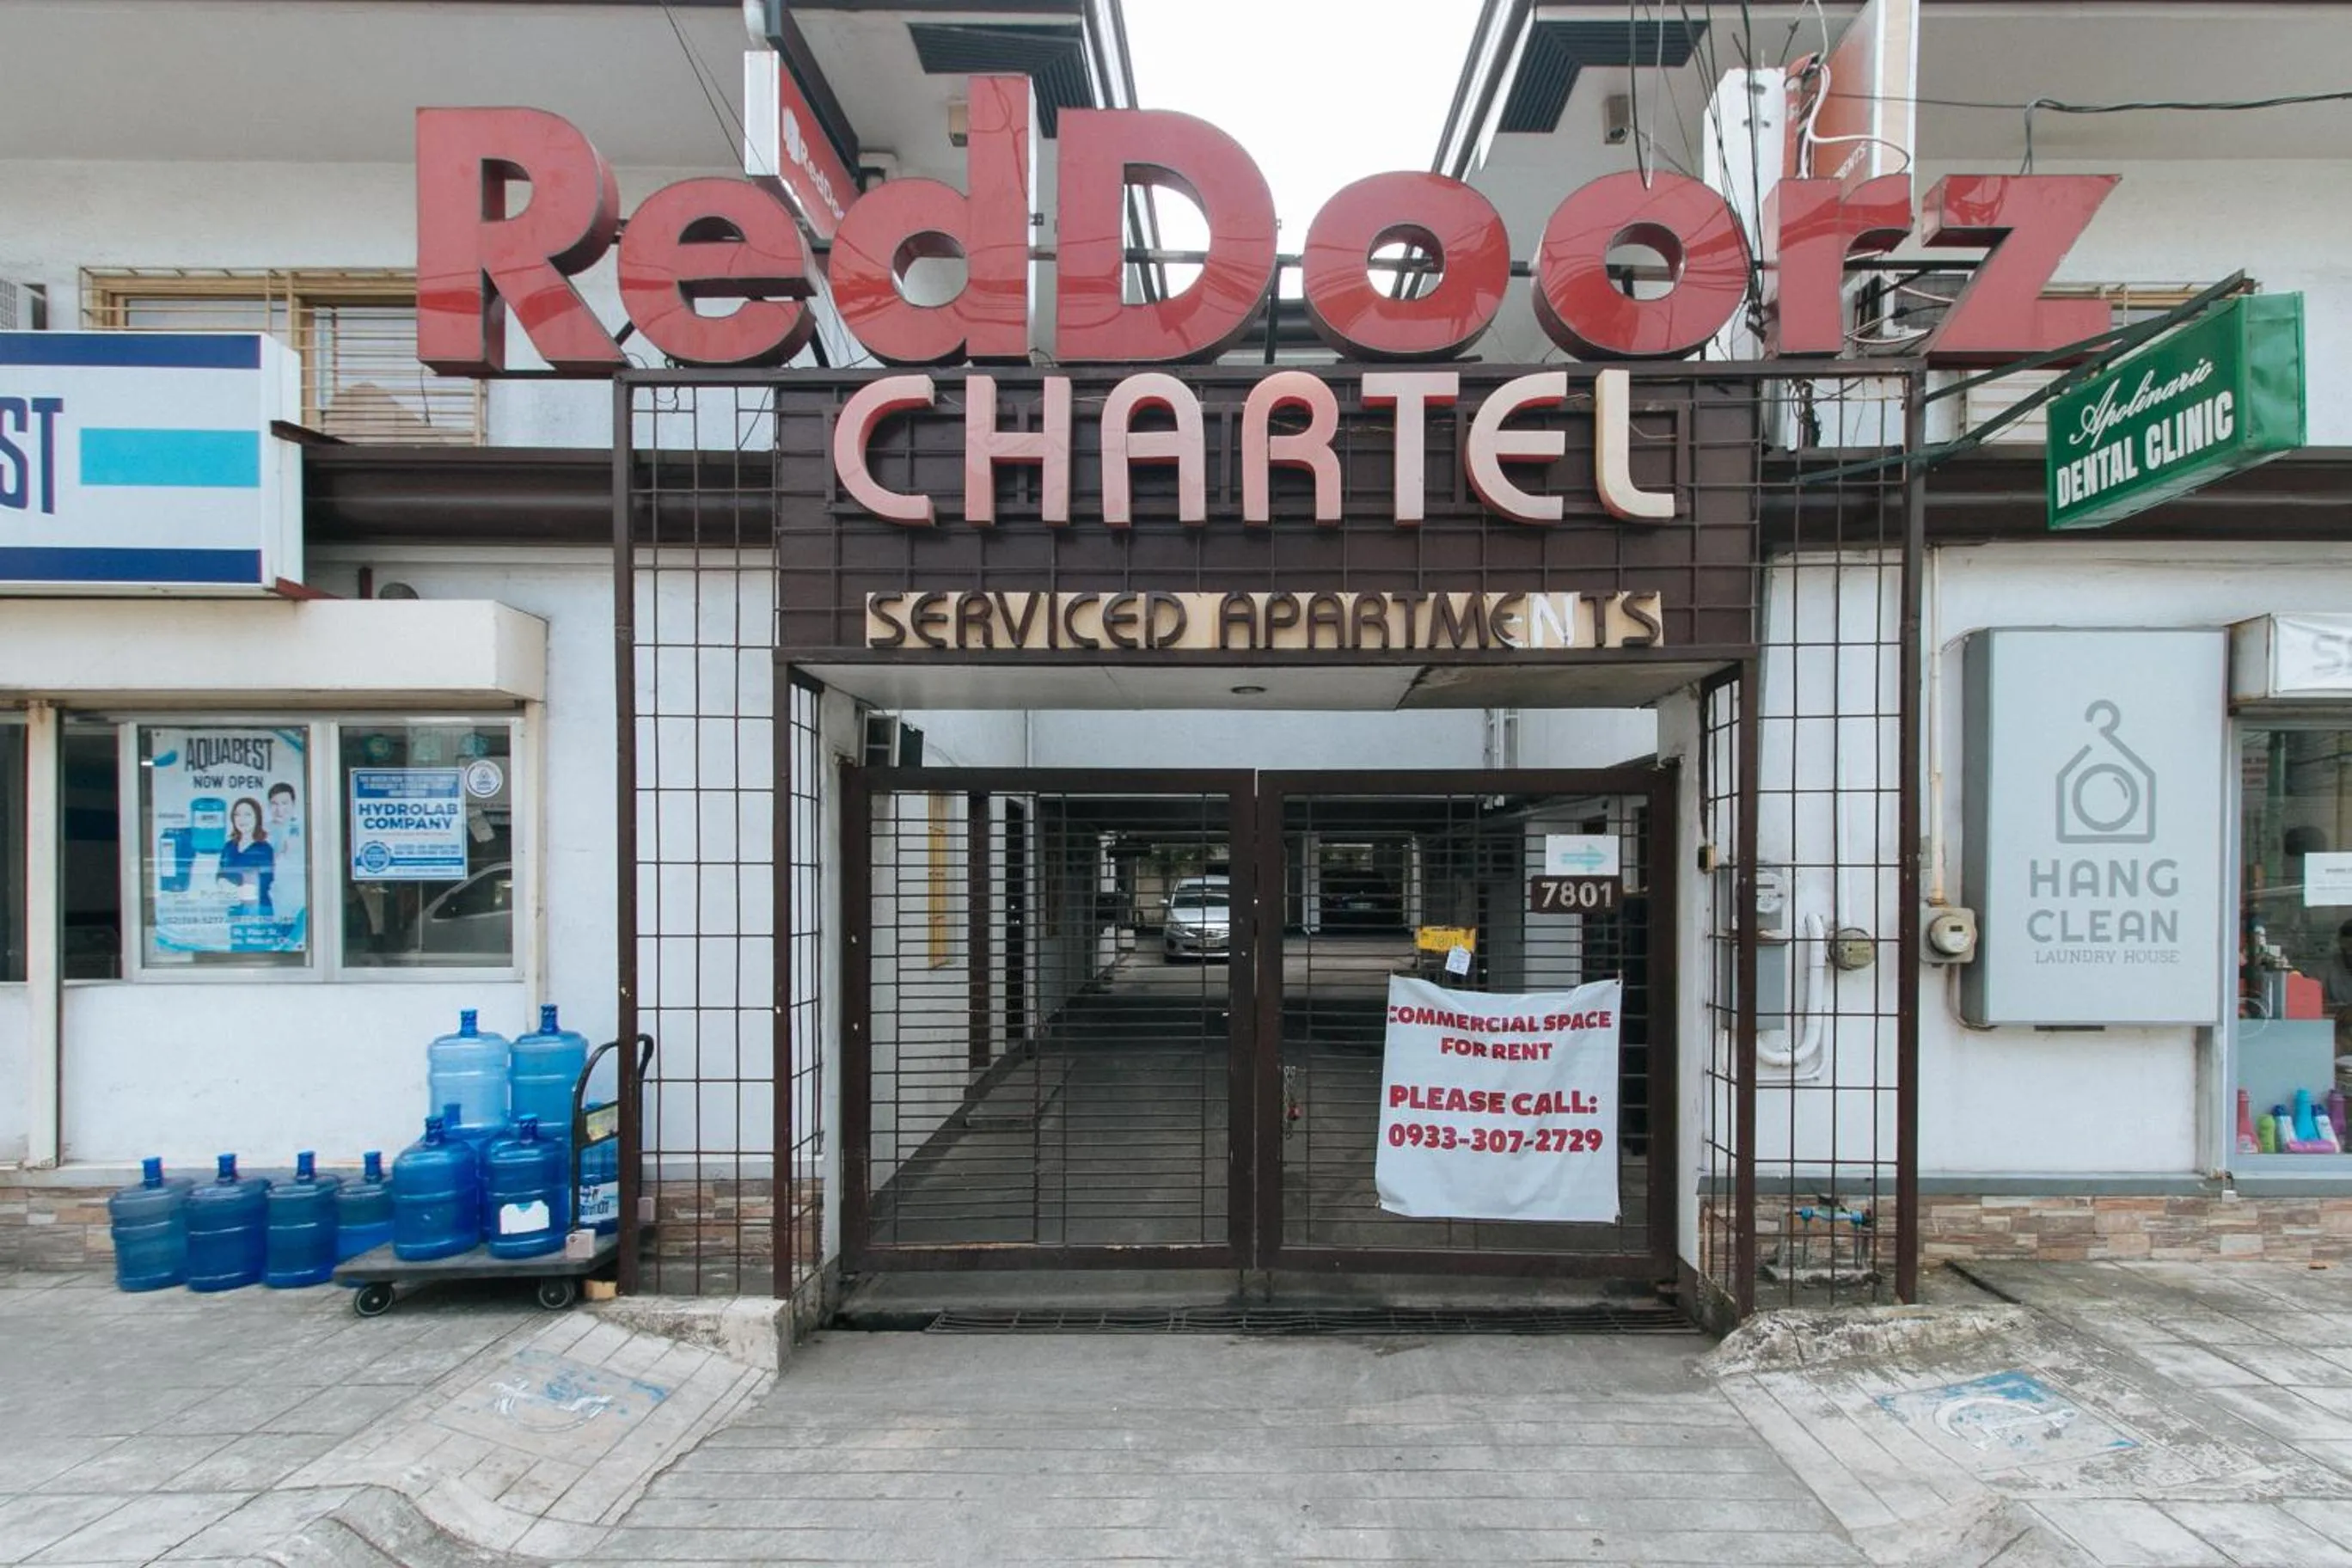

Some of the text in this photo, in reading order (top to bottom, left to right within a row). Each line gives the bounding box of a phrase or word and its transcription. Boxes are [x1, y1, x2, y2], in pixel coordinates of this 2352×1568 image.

[416, 72, 2122, 376] RedDoorz
[2069, 358, 2214, 448] Apolinario
[833, 369, 1675, 527] CHARTEL
[2056, 391, 2233, 509] DENTAL CLINIC
[869, 591, 1660, 650] SERVICED APARTMENTS
[185, 738, 274, 772] AQUABEST
[193, 775, 264, 789] NOW OPEN
[358, 803, 458, 816] HYDROLAB
[363, 818, 452, 830] COMPANY
[2030, 860, 2179, 897] HANG
[1540, 881, 1613, 908] 7801
[2027, 910, 2178, 943] CLEAN
[2035, 950, 2181, 965] LAUNDRY HOUSE
[1543, 1010, 1612, 1031] SPACE
[1441, 1038, 1553, 1061] FOR RENT
[1389, 1085, 1598, 1116] PLEASE CALL:
[1388, 1123, 1604, 1154] 0933-307-2729
